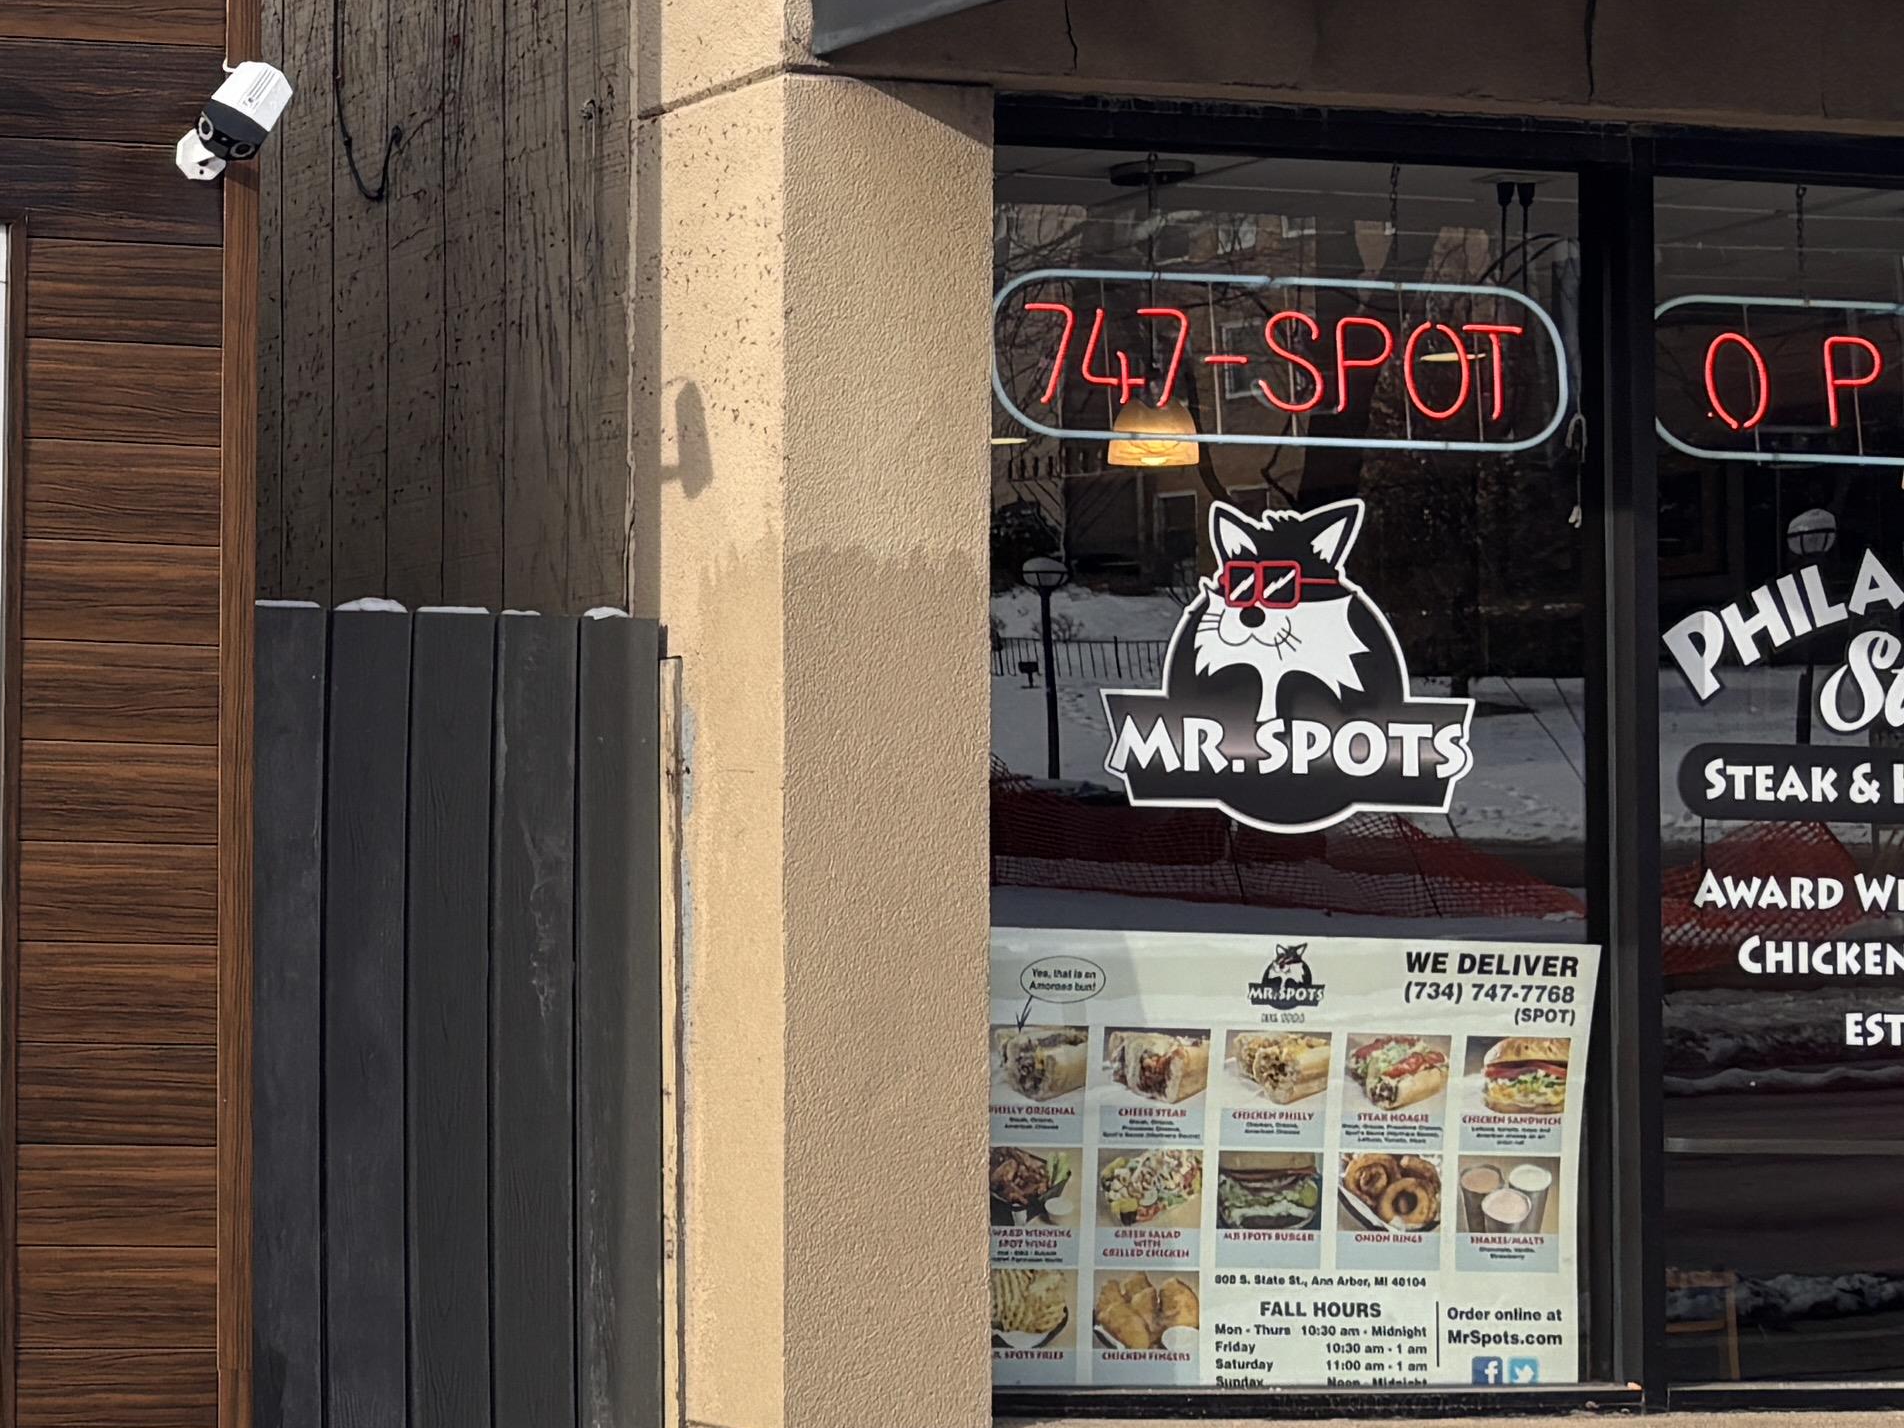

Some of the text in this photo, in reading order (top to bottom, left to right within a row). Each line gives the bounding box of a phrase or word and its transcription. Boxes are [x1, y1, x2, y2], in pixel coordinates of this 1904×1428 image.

[1023, 300, 1523, 421] 747-SPOT
[1662, 548, 1904, 700] PHILA
[1112, 713, 1468, 778] MR. SPOTS
[1704, 757, 1838, 804] STEAK
[1849, 762, 1881, 805] &
[1692, 868, 1845, 910] AWARD
[1737, 934, 1904, 976] CHICKEN
[1405, 951, 1579, 978] WE DELIVER
[1031, 968, 1097, 980] Yes, that is an
[1248, 987, 1324, 1001] MR. SPOTS
[1404, 981, 1575, 1004] (734) 747-7768
[1514, 1008, 1576, 1026] (SPOT)
[1025, 1106, 1075, 1116] ORIGINAL
[1118, 1107, 1187, 1118] CHEESE STEAK
[1232, 1110, 1314, 1121] CHICKEN PHILLY
[1357, 1112, 1430, 1123] STEAK HOAGIE
[1462, 1115, 1562, 1126] CHICKEN SANDWICH
[992, 1229, 1023, 1238] WARD
[1148, 1230, 1181, 1239] SALAD
[1274, 1233, 1315, 1242] BURGER
[1355, 1234, 1423, 1243] ONION RINGS
[1133, 1239, 1161, 1248] WITH
[1145, 1248, 1190, 1258] CHICKEN
[1239, 1274, 1251, 1285] S.
[1254, 1275, 1285, 1285] State
[1311, 1276, 1334, 1286] Ann
[1337, 1275, 1371, 1288] Arbor,
[1374, 1276, 1388, 1286] MI
[1260, 1301, 1382, 1318] FALL HOURS
[1447, 1306, 1562, 1322] Order online at
[1215, 1324, 1242, 1336] Mon
[1254, 1324, 1291, 1336] Thurs
[1301, 1325, 1336, 1336] 10:30
[1340, 1327, 1360, 1336] am
[1371, 1325, 1427, 1339] Midnight
[1447, 1329, 1563, 1347] MrSpots.com
[1215, 1341, 1256, 1355] Friday
[1326, 1343, 1361, 1354] 10:30
[1364, 1345, 1384, 1354] am
[1396, 1343, 1403, 1354] 1
[1407, 1345, 1427, 1354] am
[1102, 1352, 1191, 1362] CHICKEN FINGERS
[1215, 1358, 1274, 1372] Saturday
[1326, 1360, 1361, 1371] 11:00
[1364, 1363, 1385, 1371] am
[1396, 1361, 1403, 1371] 1
[1407, 1363, 1428, 1372] am
[1216, 1376, 1264, 1388] Sunday
